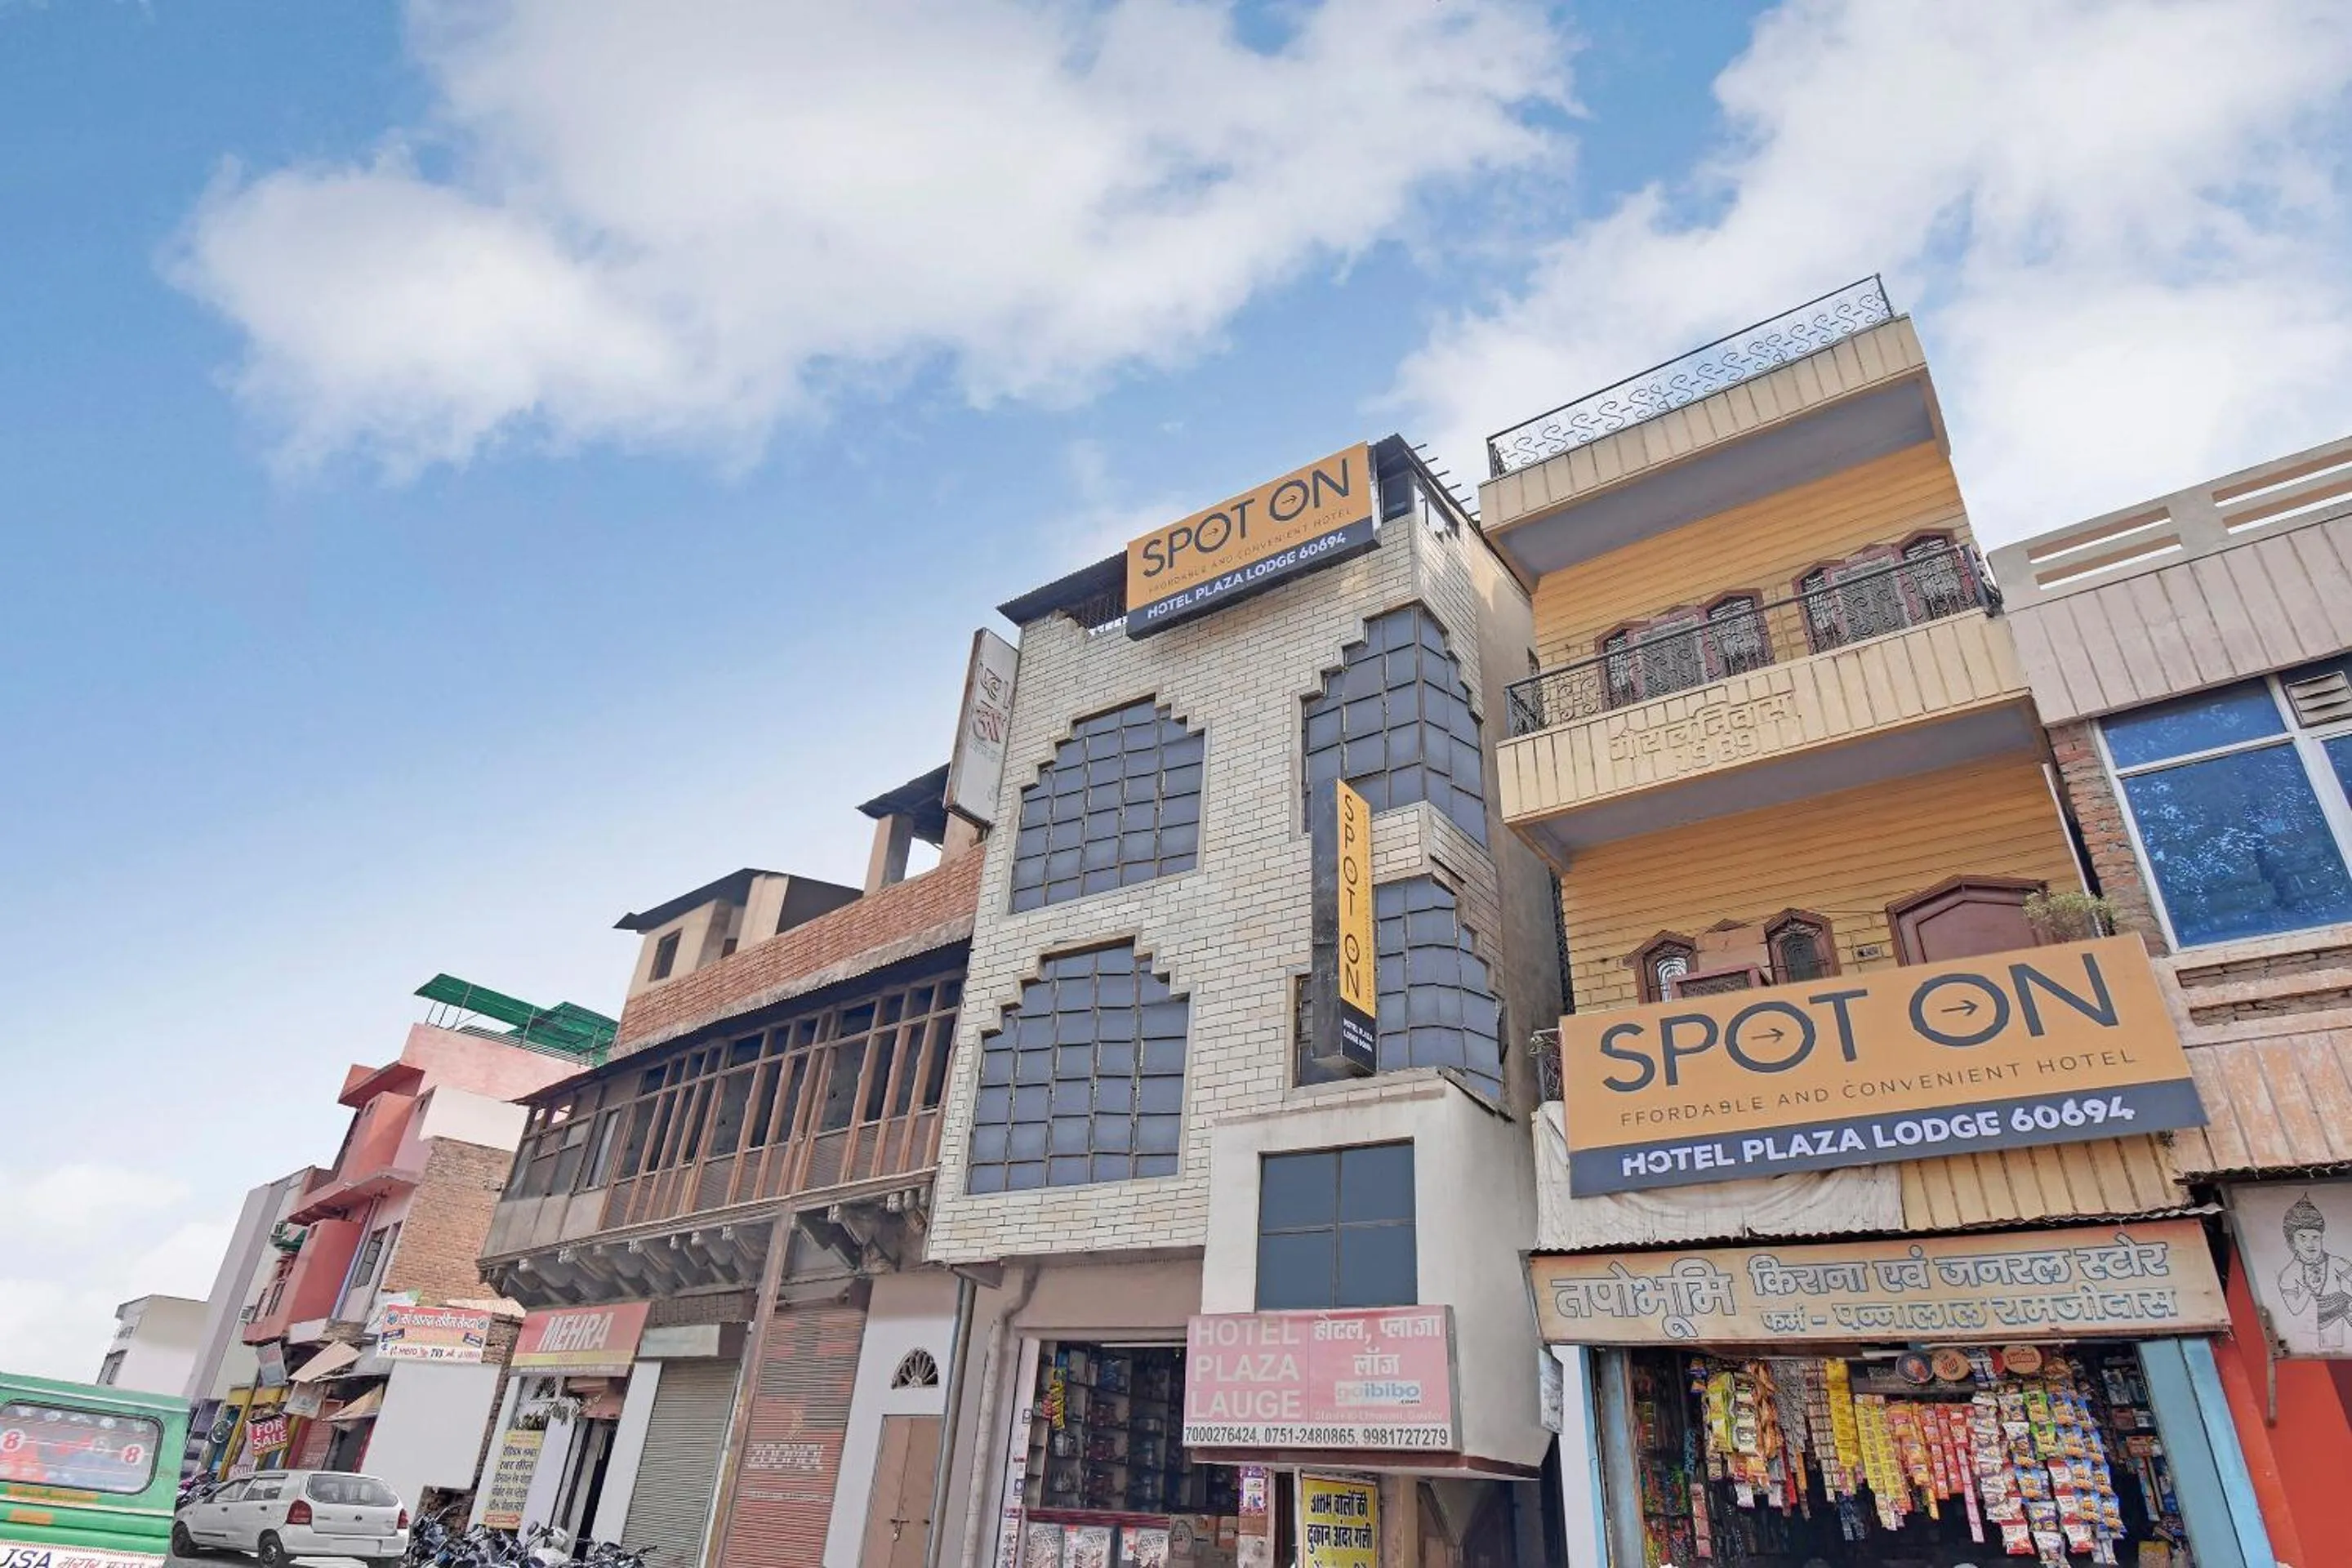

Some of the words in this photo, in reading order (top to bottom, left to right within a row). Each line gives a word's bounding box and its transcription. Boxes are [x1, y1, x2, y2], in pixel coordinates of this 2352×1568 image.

[1143, 499, 1255, 577] SPOT
[1269, 458, 1350, 521] ON
[1313, 509, 1352, 529] HOTEL
[1147, 594, 1192, 618] HOTEL
[1196, 572, 1244, 600] PLAZA
[1246, 551, 1297, 581] LODGE
[1299, 532, 1347, 559] 60694
[1343, 794, 1359, 916] SPOT
[1344, 933, 1361, 1000] ON
[1600, 989, 1869, 1093] SPOT
[1909, 952, 2120, 1047] ON
[1621, 1096, 1763, 1127] FFORDABLE
[1777, 1087, 1829, 1106] AND
[1842, 1063, 2021, 1100] CONVENIENT
[2038, 1049, 2137, 1074] HOTEL
[1621, 1144, 1735, 1177] HOTEL
[1743, 1129, 1866, 1164] PLAZA
[1872, 1111, 2002, 1149] LODGE
[2010, 1095, 2136, 1133] 60694
[1551, 1258, 1737, 1339] तपोभूमि
[1748, 1254, 1869, 1296] किराना
[1873, 1245, 1931, 1293] एवं
[1933, 1250, 2072, 1288] जनरल
[2074, 1233, 2169, 1281] स्टोर
[535, 1312, 615, 1352] MEHRA
[1196, 1317, 1300, 1347] HOTEL
[1194, 1353, 1300, 1383] PLAZA
[256, 1417, 284, 1437] FOR
[1190, 1389, 1303, 1419] LAUGE
[253, 1430, 288, 1450] SALE
[1363, 1428, 1449, 1446] 9981727279
